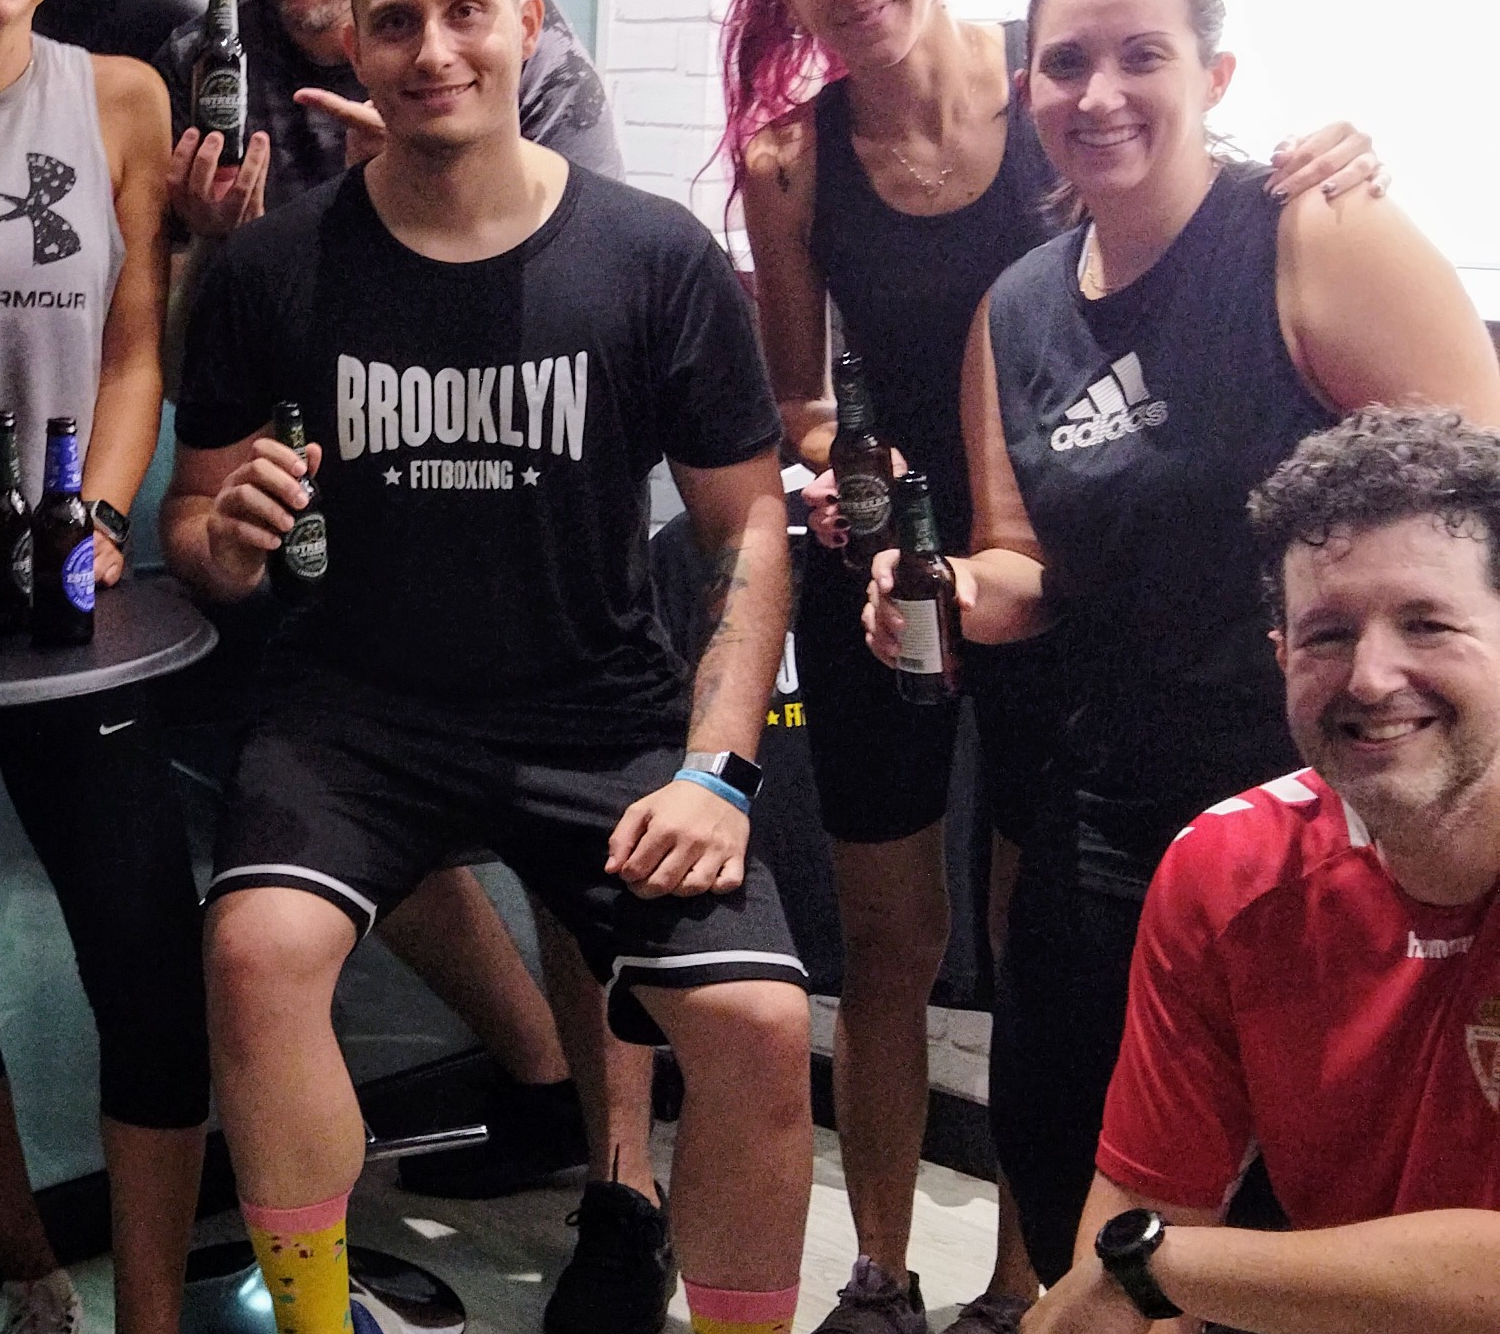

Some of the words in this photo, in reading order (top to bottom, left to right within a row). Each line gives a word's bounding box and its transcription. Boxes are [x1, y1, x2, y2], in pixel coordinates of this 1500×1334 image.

[336, 351, 588, 461] BROOKLYN
[1051, 401, 1169, 451] adidas
[410, 460, 514, 490] FITBOXING
